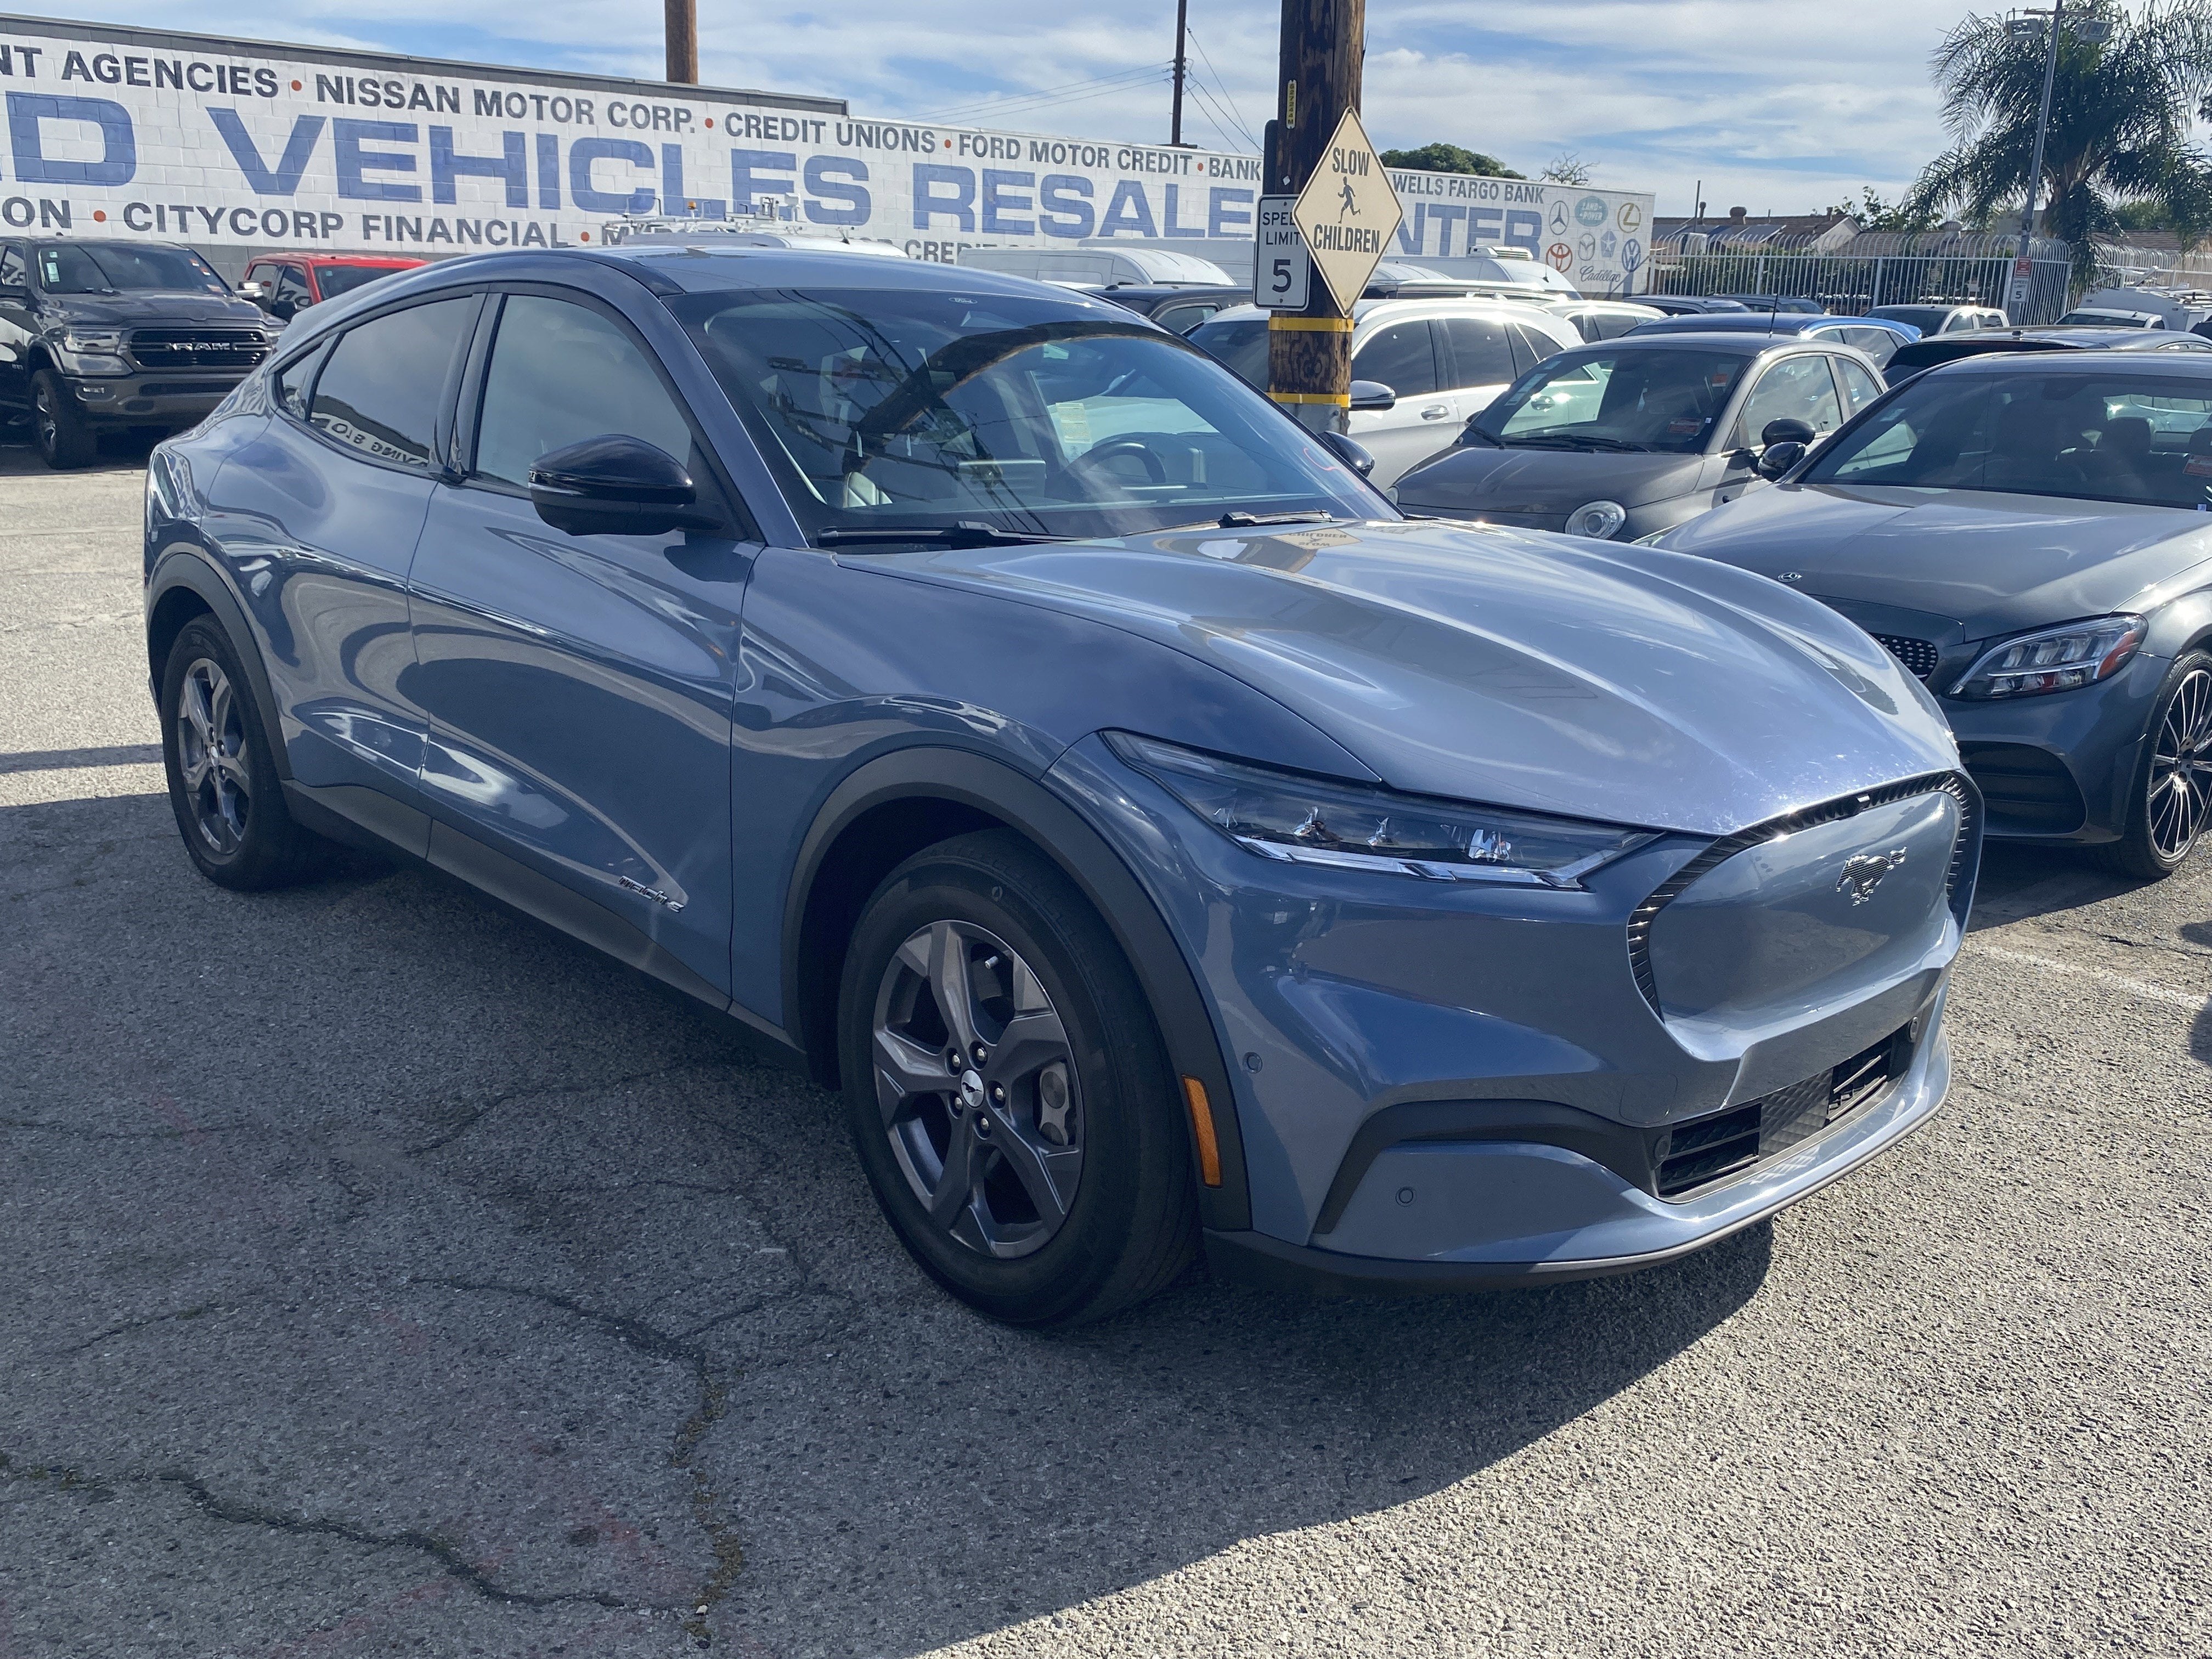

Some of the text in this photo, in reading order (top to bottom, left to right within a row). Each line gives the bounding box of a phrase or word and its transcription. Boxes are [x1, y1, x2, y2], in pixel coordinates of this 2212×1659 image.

[61, 50, 278, 98] AGENCIES
[316, 74, 460, 114] NISSAN
[473, 89, 595, 125] MOTOR
[608, 101, 695, 133] CORP.
[725, 112, 826, 144] CREDIT
[836, 122, 935, 153] UNIONS
[960, 134, 1021, 160] FORD
[1030, 141, 1110, 168] MOTOR
[1118, 149, 1193, 175] CREDIT
[1209, 157, 1261, 181] BANK
[1392, 174, 1443, 195] WELLS
[1449, 179, 1499, 200] FARGO
[1505, 184, 1545, 204] BANK
[5, 91, 1542, 260] D VEHICLES RESALE NTER
[1333, 147, 1370, 176] SLOW
[2, 197, 71, 229] ON
[123, 202, 343, 239] CITYCORP
[362, 215, 569, 249] FINANCIAL
[1262, 212, 1296, 225] SPEE
[1266, 232, 1300, 245] LIMIT
[1313, 224, 1380, 253] CHILDREN
[1272, 259, 1291, 292] 5
[1580, 266, 1621, 282] Cadillac
[2015, 291, 2022, 299] 5
[172, 342, 230, 351] RAM
